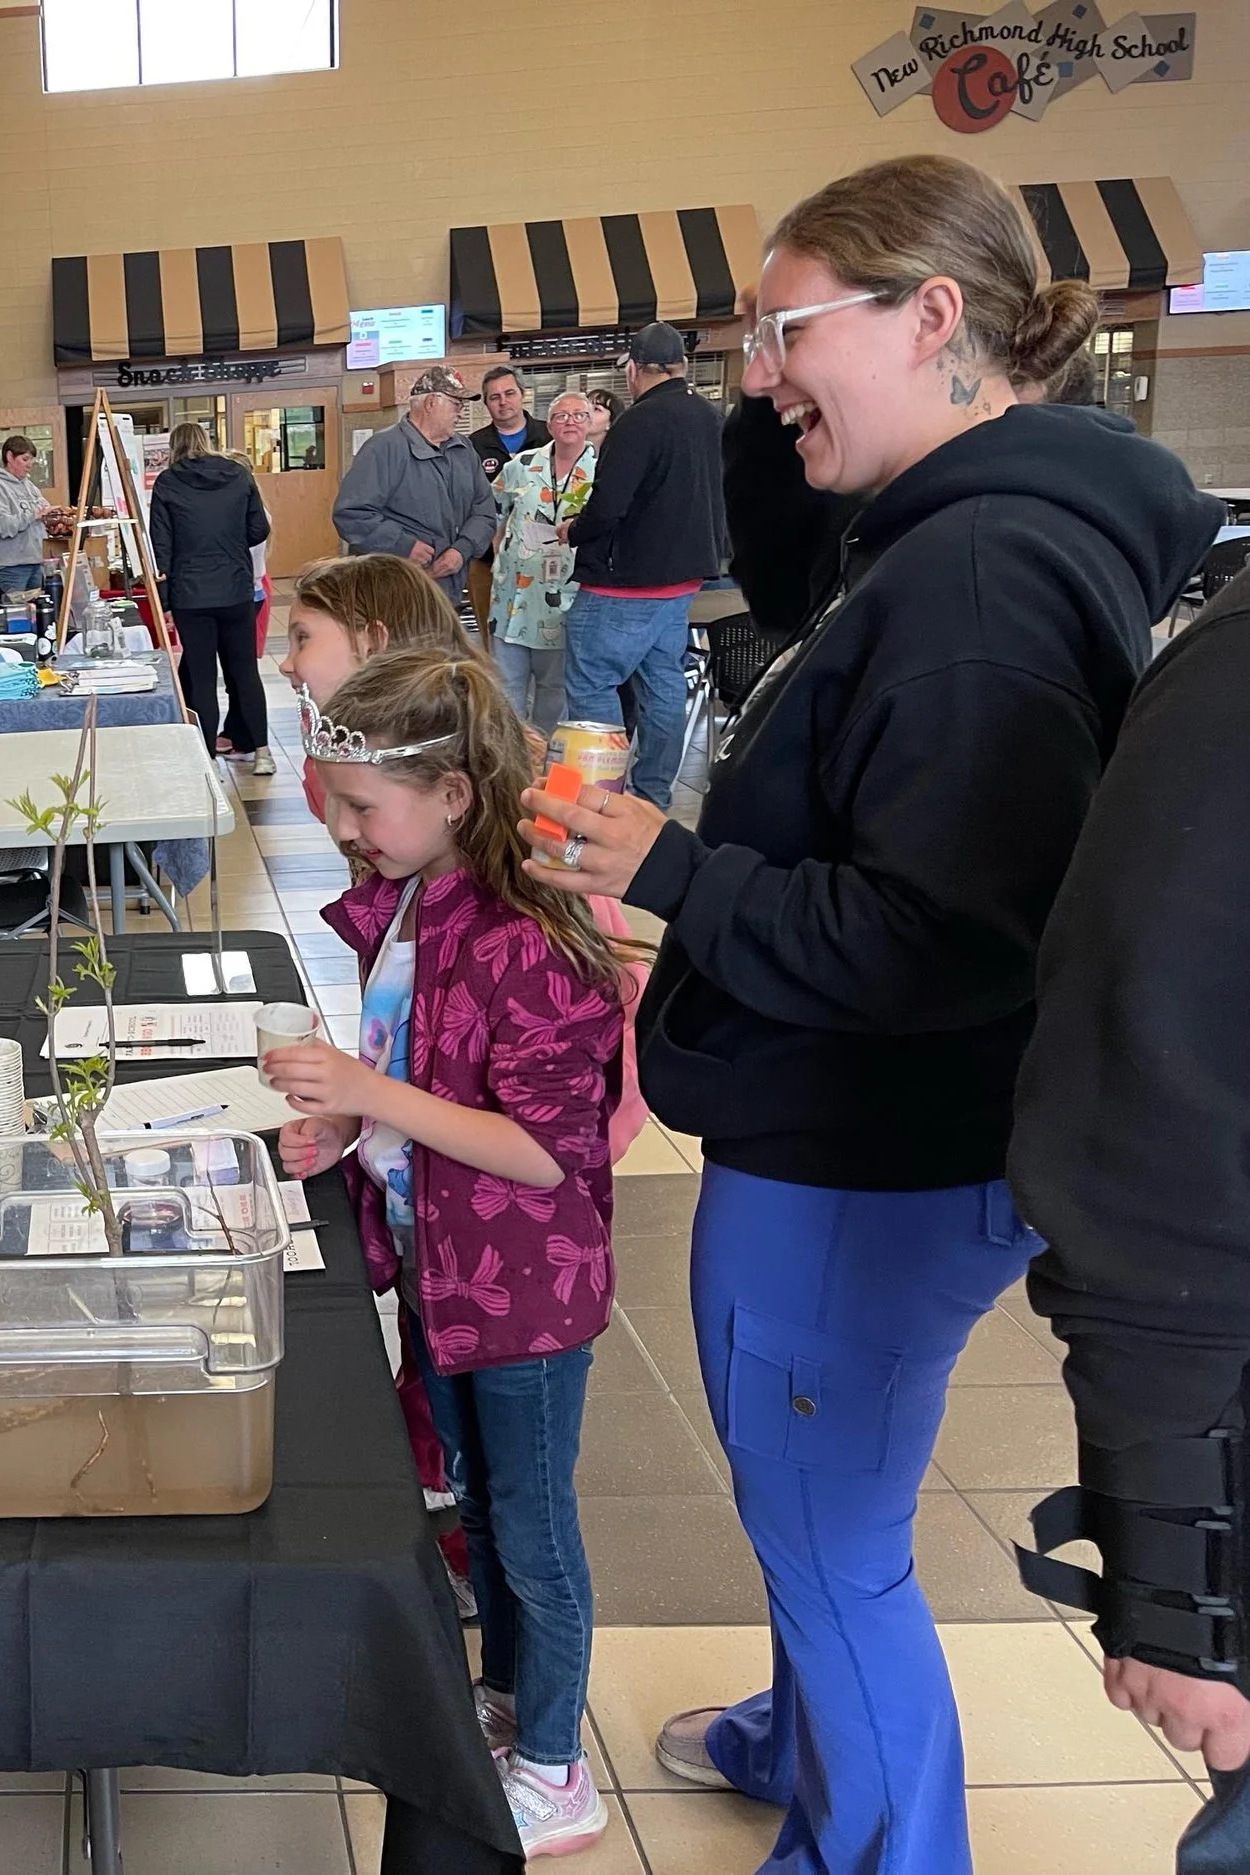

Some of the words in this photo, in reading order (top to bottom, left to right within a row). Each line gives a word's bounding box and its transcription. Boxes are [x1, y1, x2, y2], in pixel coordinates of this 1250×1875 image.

[871, 57, 919, 93] New
[919, 20, 1044, 61] Richmond
[1045, 22, 1105, 60] High
[1111, 27, 1190, 60] School
[950, 50, 1055, 120] Café
